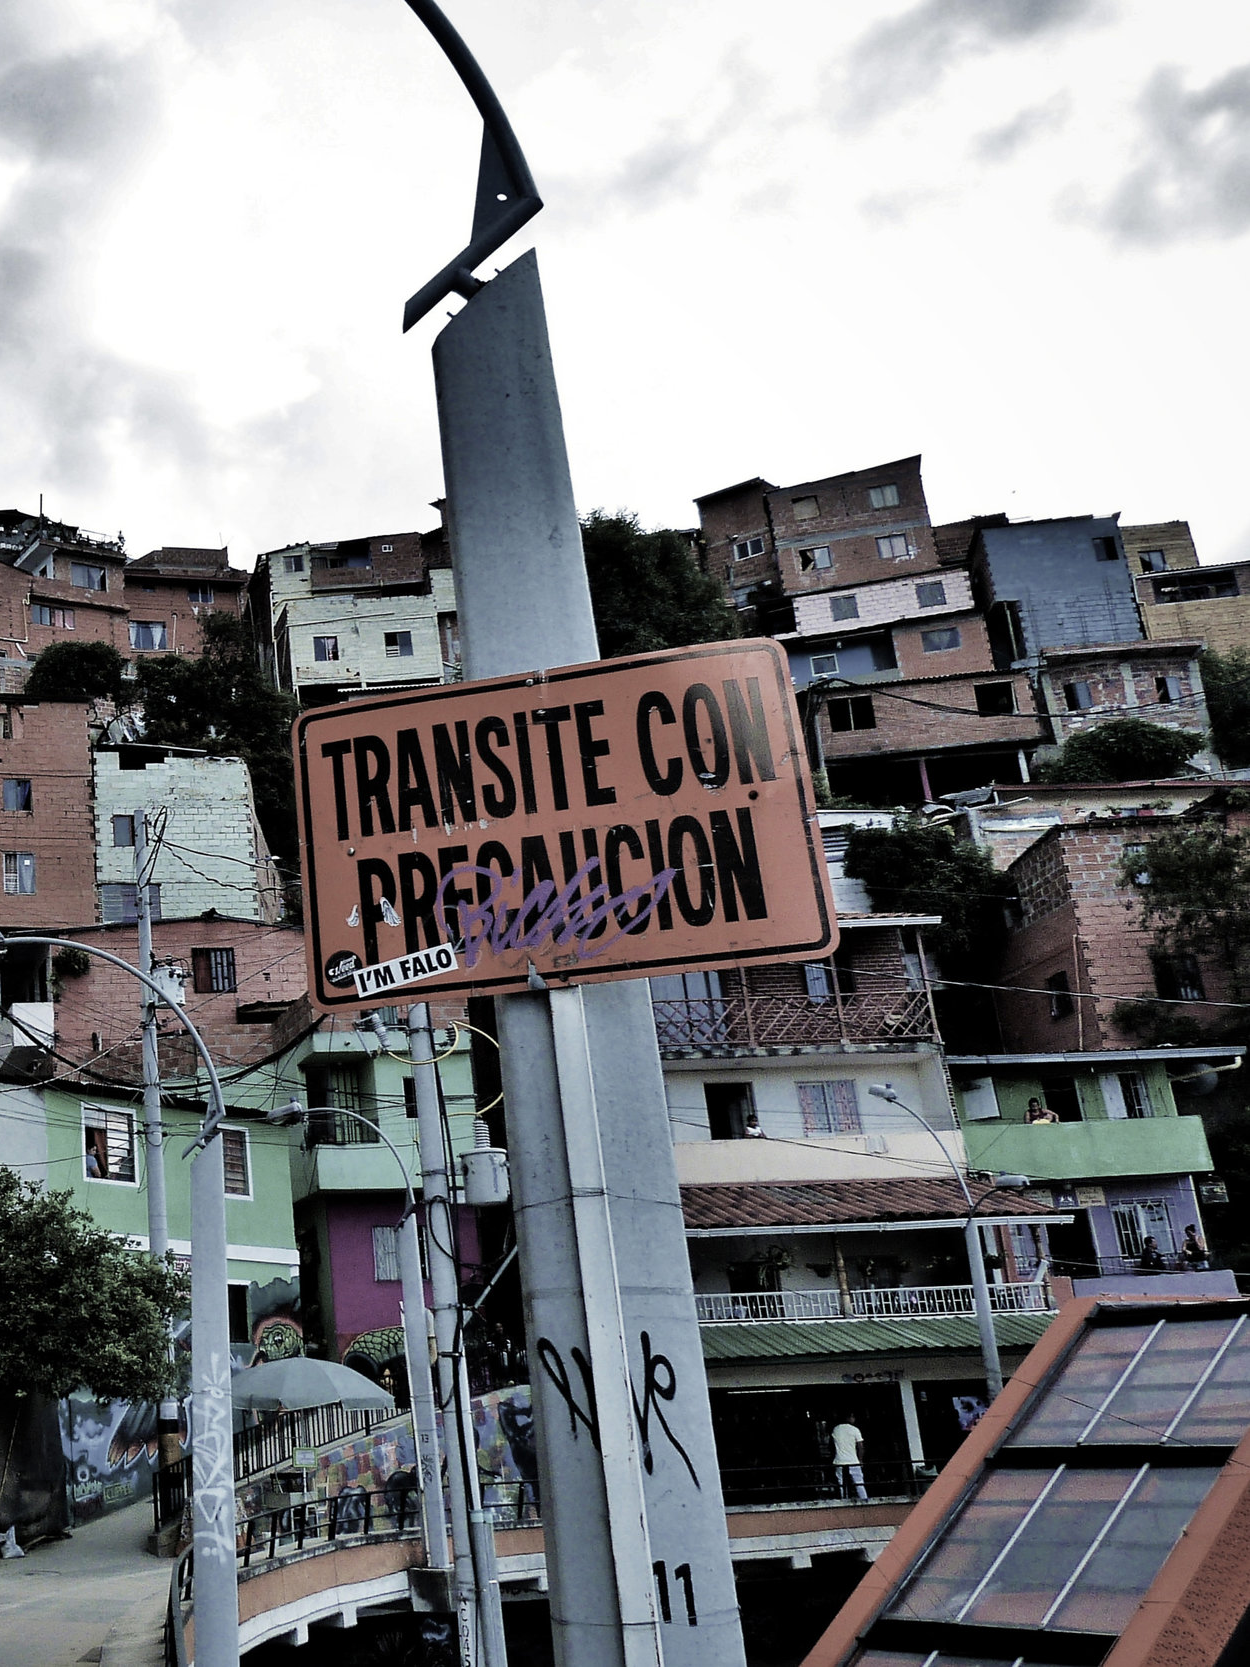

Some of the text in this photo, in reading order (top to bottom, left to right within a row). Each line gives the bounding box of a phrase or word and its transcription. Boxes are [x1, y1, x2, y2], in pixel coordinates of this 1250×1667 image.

[321, 677, 777, 841] TRANSITE CON
[357, 807, 767, 966] PRECAUCION
[357, 965, 395, 993] I'M
[399, 948, 452, 981] FALO
